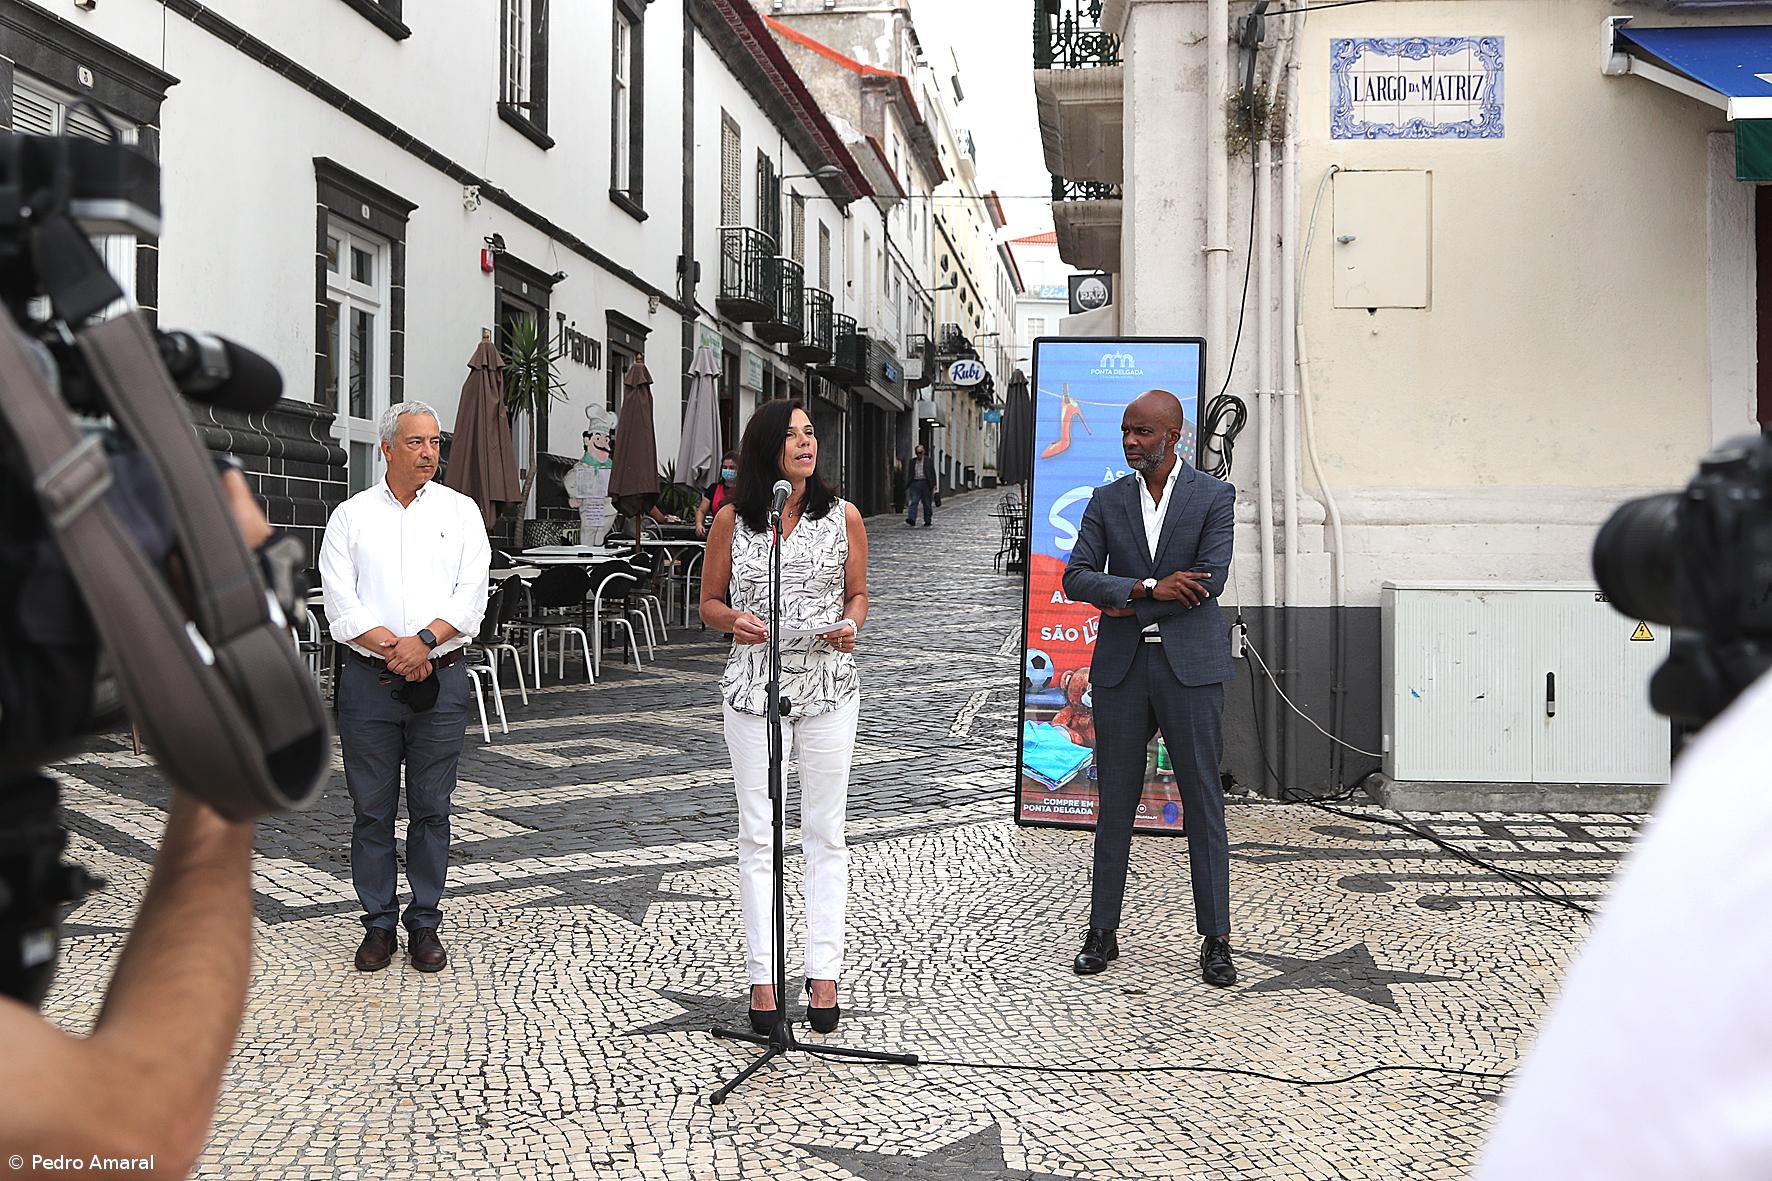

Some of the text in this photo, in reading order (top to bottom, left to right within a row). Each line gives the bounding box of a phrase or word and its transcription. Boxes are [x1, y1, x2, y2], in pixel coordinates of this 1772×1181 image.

[1353, 75, 1484, 101] LARGO DA MATRIZ
[556, 312, 601, 371] Trianon
[952, 362, 980, 381] Rubi
[1040, 624, 1079, 641] SÃO
[1023, 804, 1094, 815] PONTA DELGADA
[1043, 798, 1094, 808] COMPRE EM
